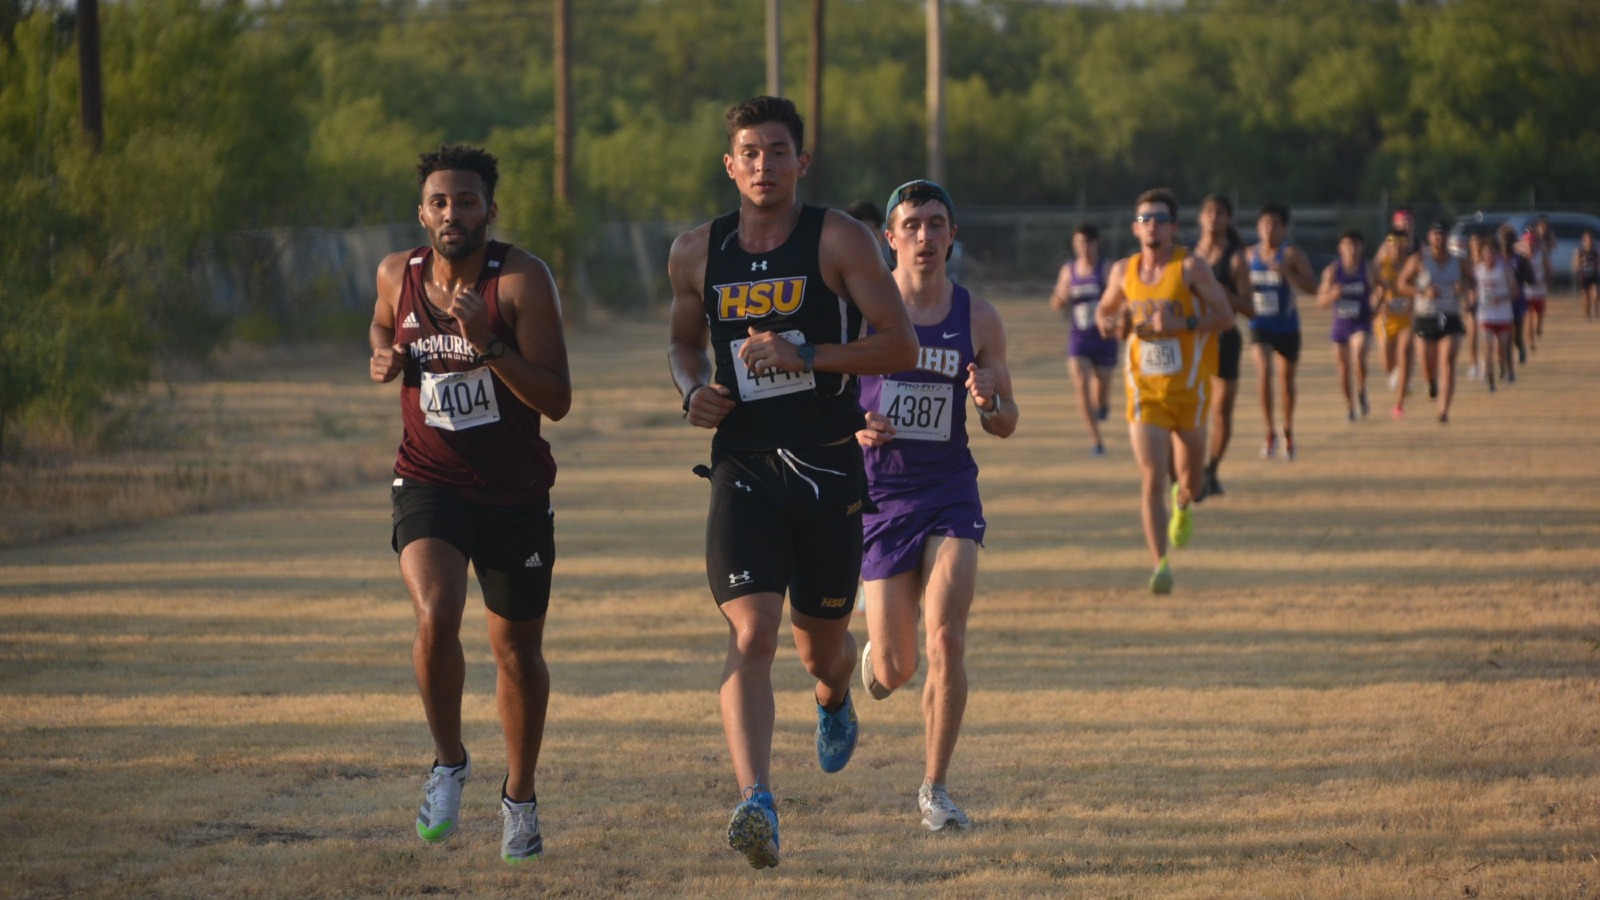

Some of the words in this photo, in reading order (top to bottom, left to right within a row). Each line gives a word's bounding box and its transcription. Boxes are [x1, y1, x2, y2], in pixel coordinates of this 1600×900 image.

[713, 277, 806, 320] HSU
[410, 334, 476, 359] McMURR
[427, 379, 490, 418] 4404
[886, 394, 947, 429] 4387
[819, 597, 847, 608] HSU
